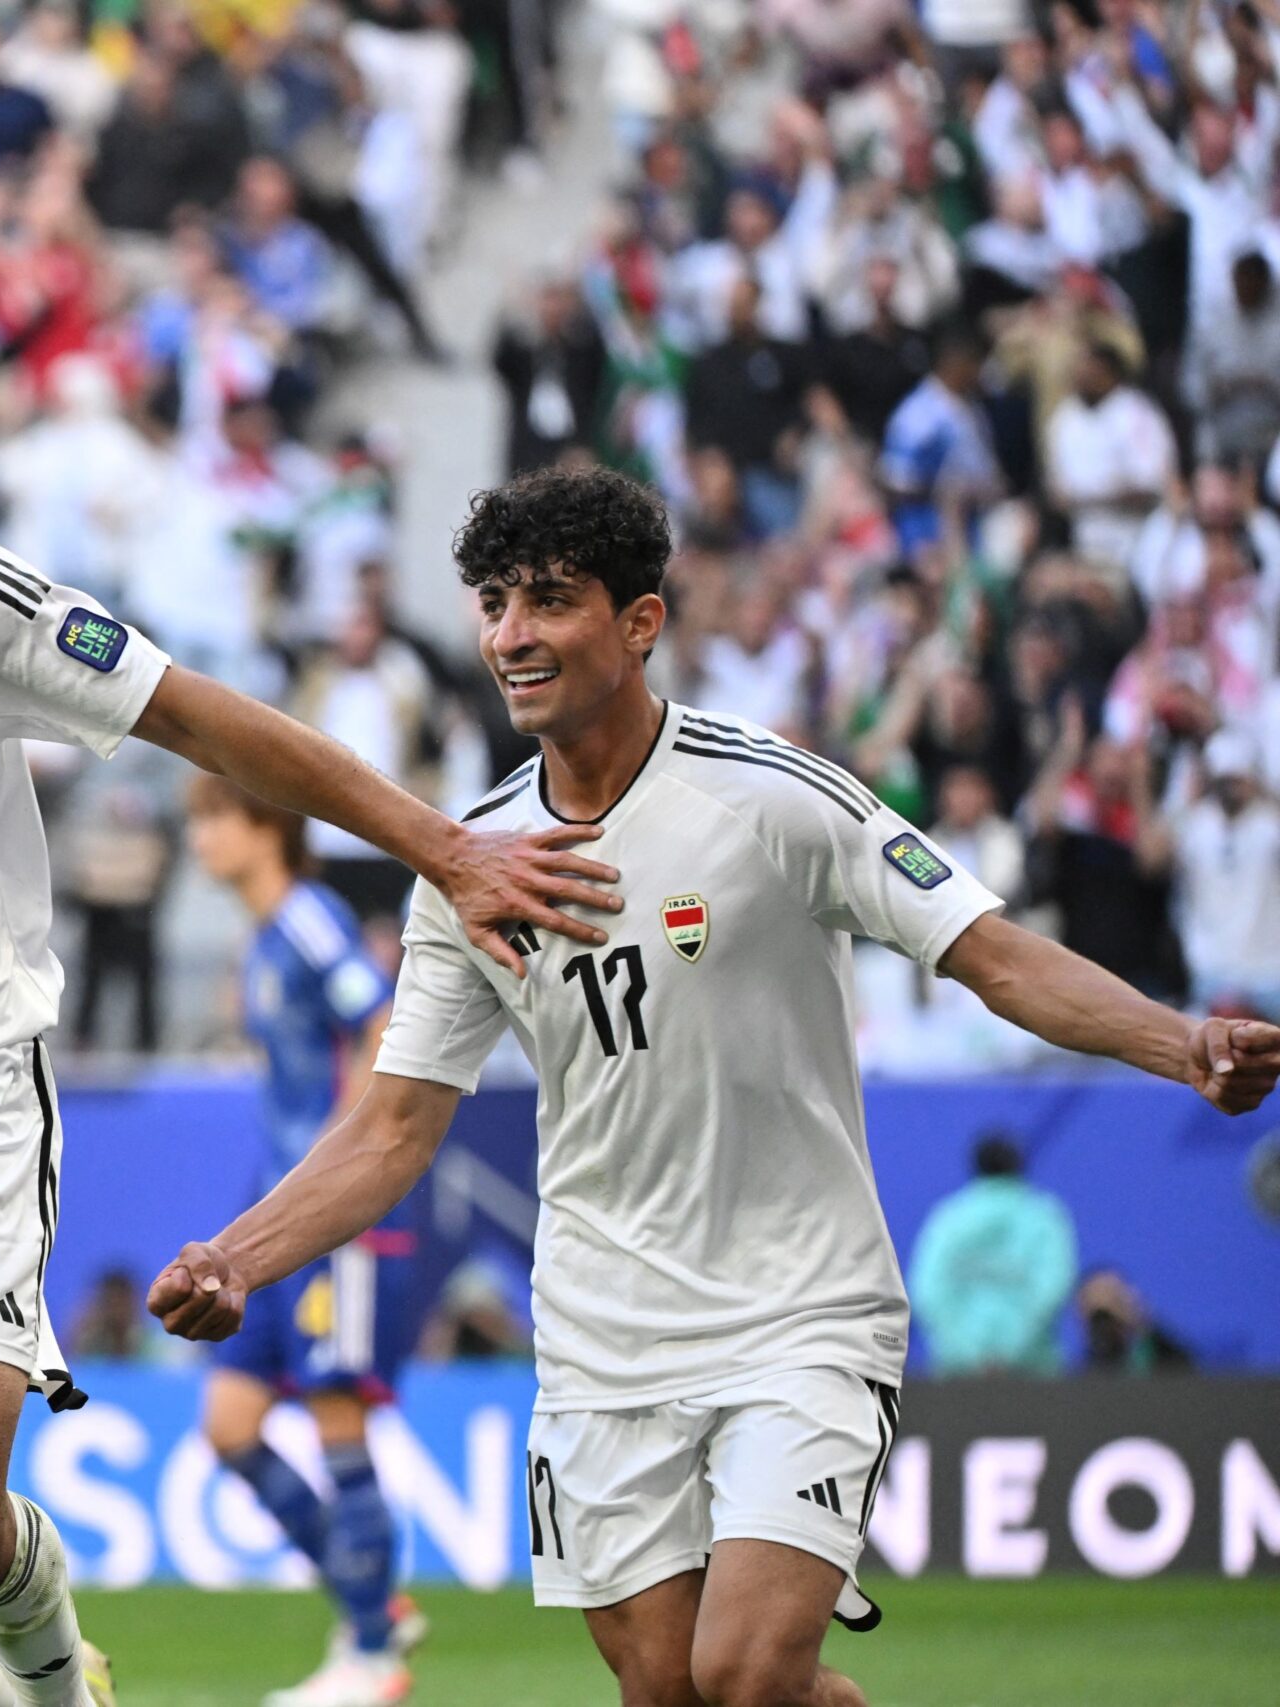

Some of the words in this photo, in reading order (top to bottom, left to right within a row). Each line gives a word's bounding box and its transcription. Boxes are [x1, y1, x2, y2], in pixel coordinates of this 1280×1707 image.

[65, 624, 82, 646] AFC
[75, 619, 103, 655] LIVE
[669, 898, 696, 909] IRAQ
[561, 944, 649, 1057] 17
[527, 1450, 564, 1560] 17
